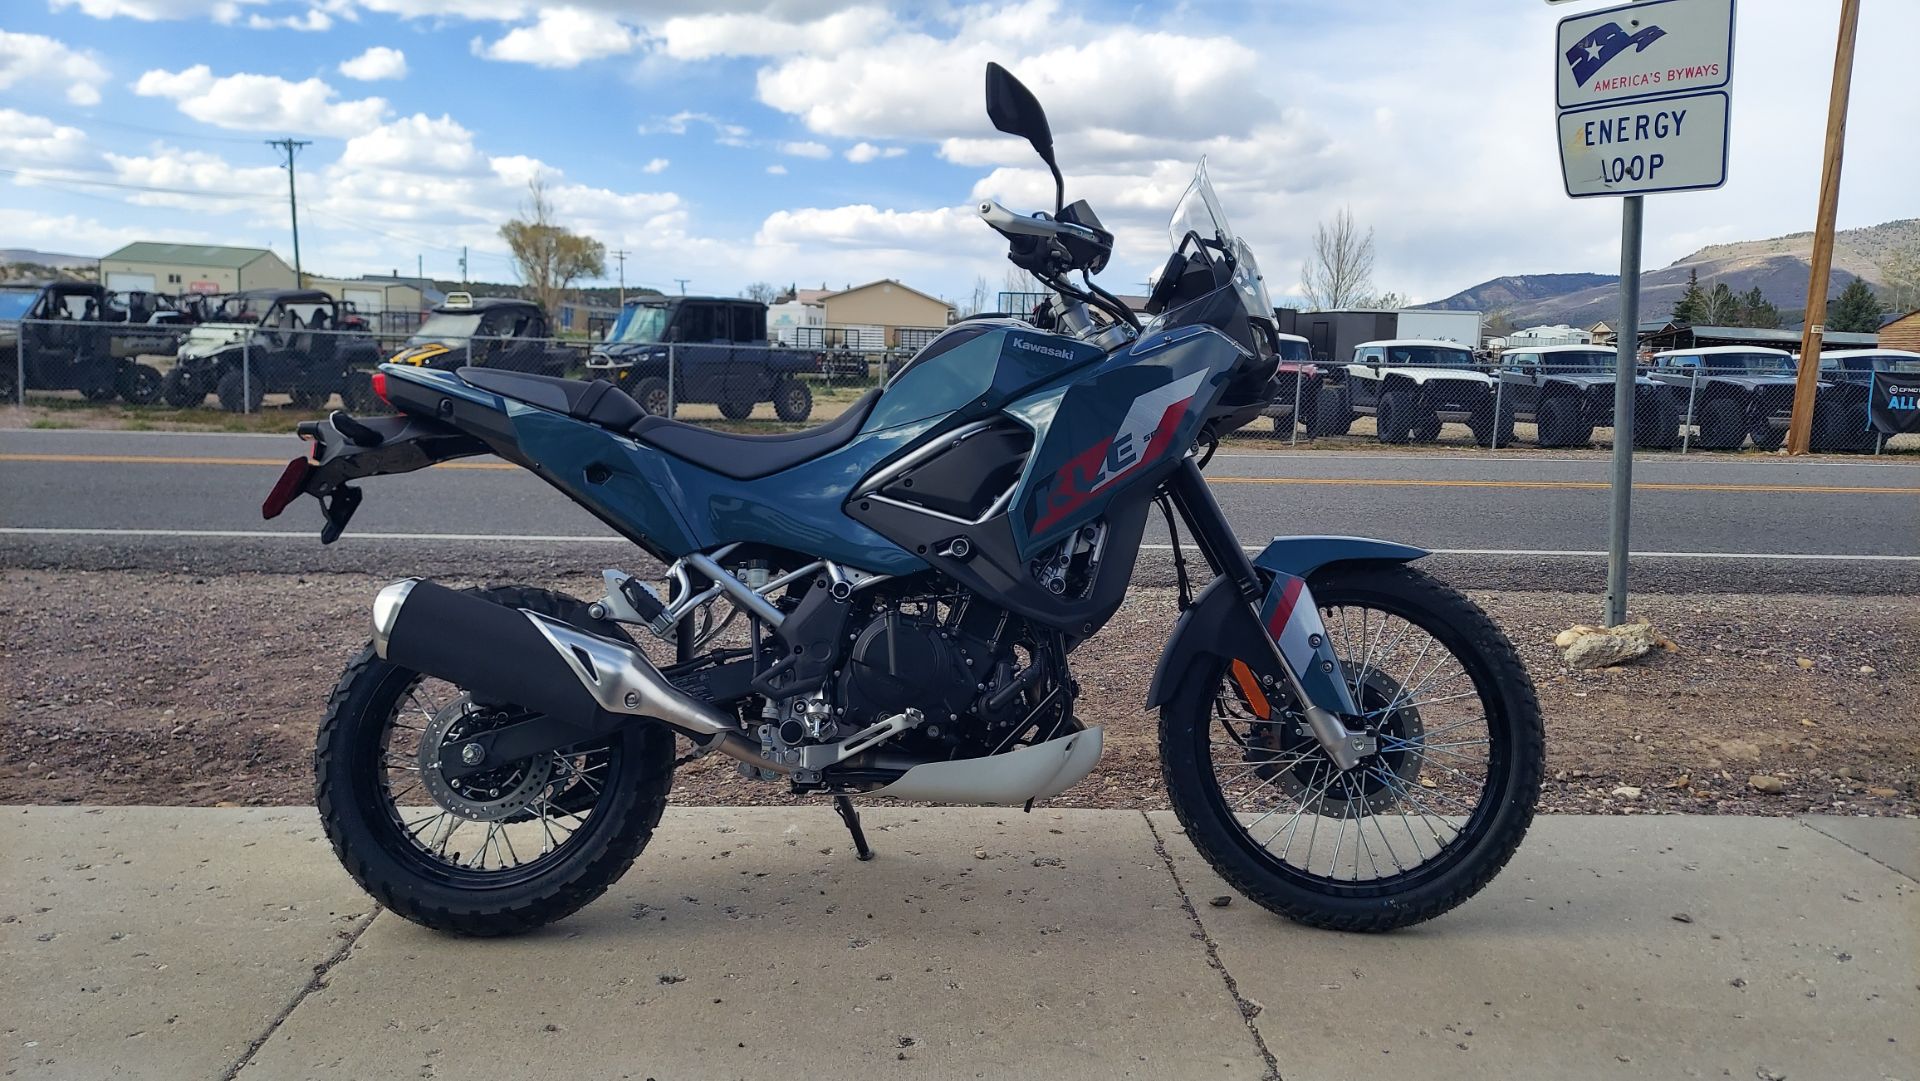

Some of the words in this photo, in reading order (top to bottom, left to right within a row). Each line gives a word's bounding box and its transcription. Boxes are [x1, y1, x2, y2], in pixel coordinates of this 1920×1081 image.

[1594, 71, 1661, 92] AMERICA'S
[1667, 63, 1719, 82] BYWAYS
[1585, 110, 1687, 146] ENERGY
[1602, 154, 1664, 182] LOOP
[1013, 338, 1074, 360] Kawasaki
[1035, 432, 1137, 517] KLE
